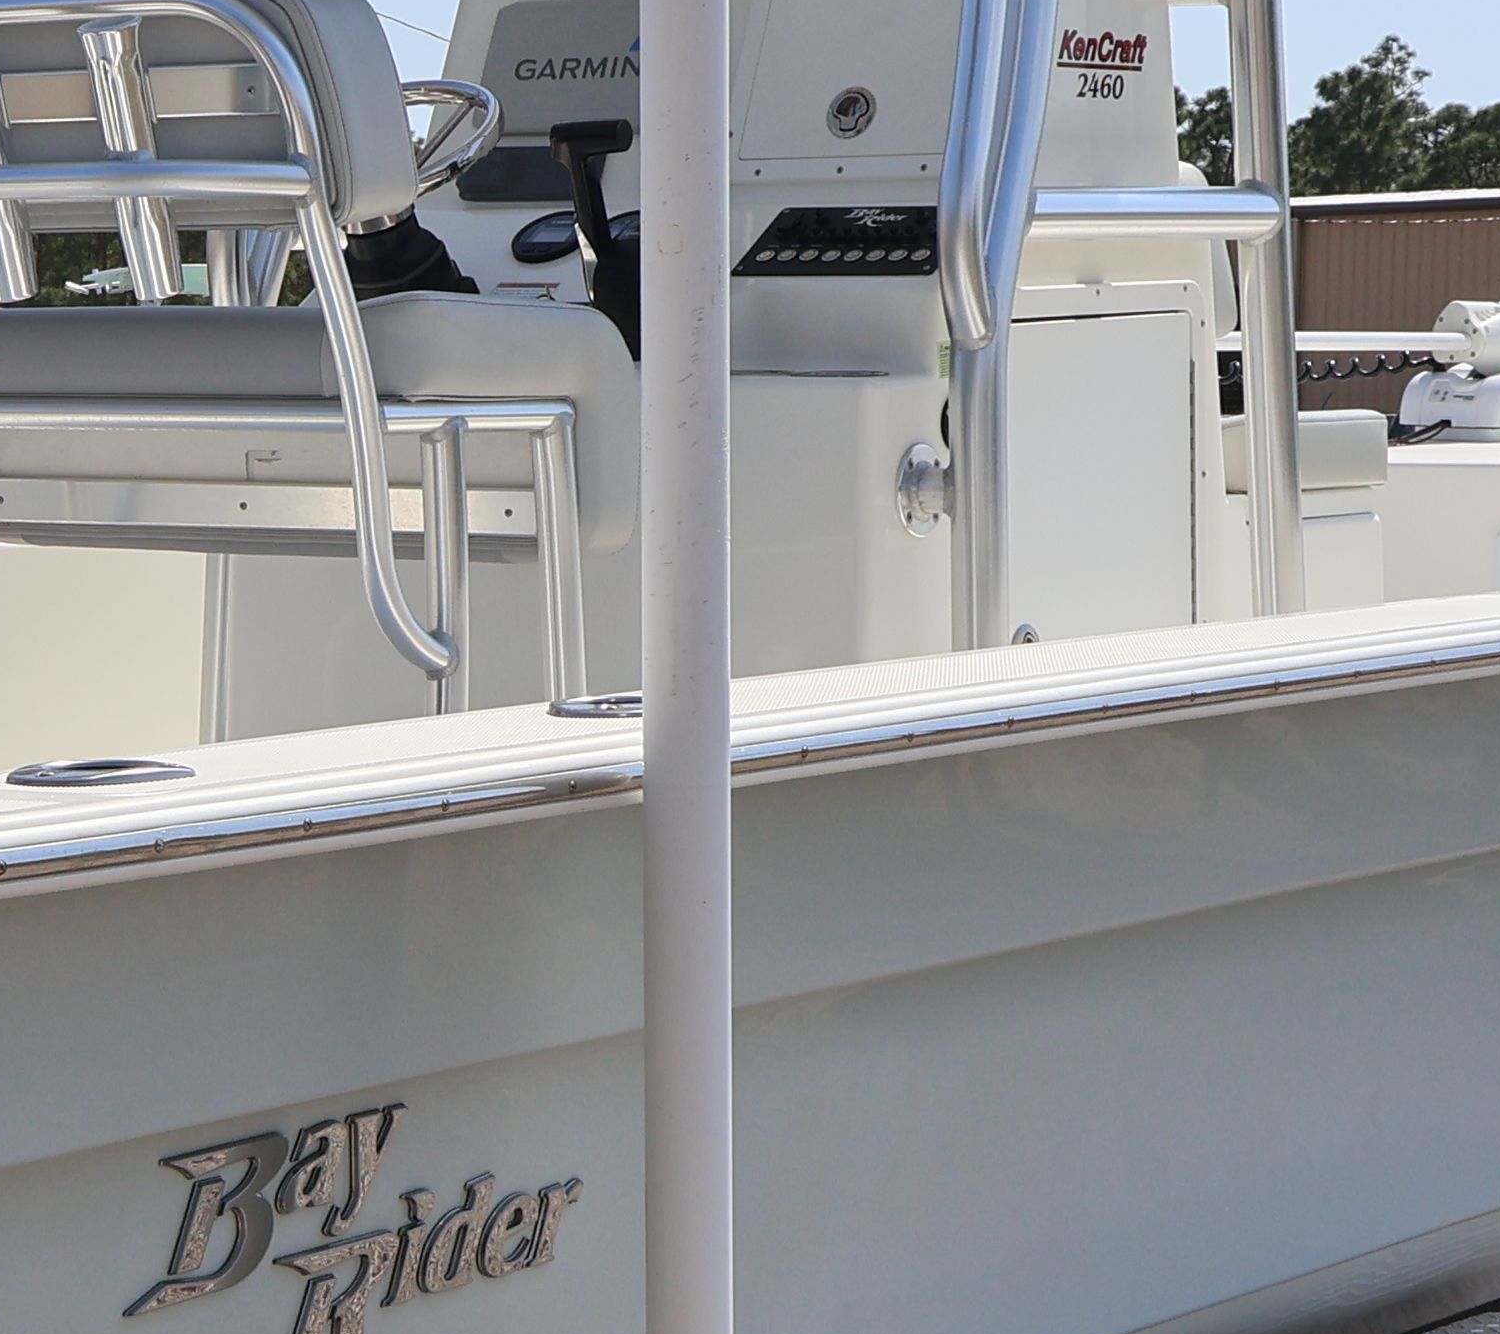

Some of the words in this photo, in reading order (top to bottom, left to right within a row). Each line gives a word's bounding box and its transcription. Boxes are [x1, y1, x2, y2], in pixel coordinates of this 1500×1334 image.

[1058, 29, 1147, 64] KenCraft
[514, 56, 640, 80] GARMIN
[1076, 72, 1124, 99] 2460
[122, 1103, 407, 1316] Bay
